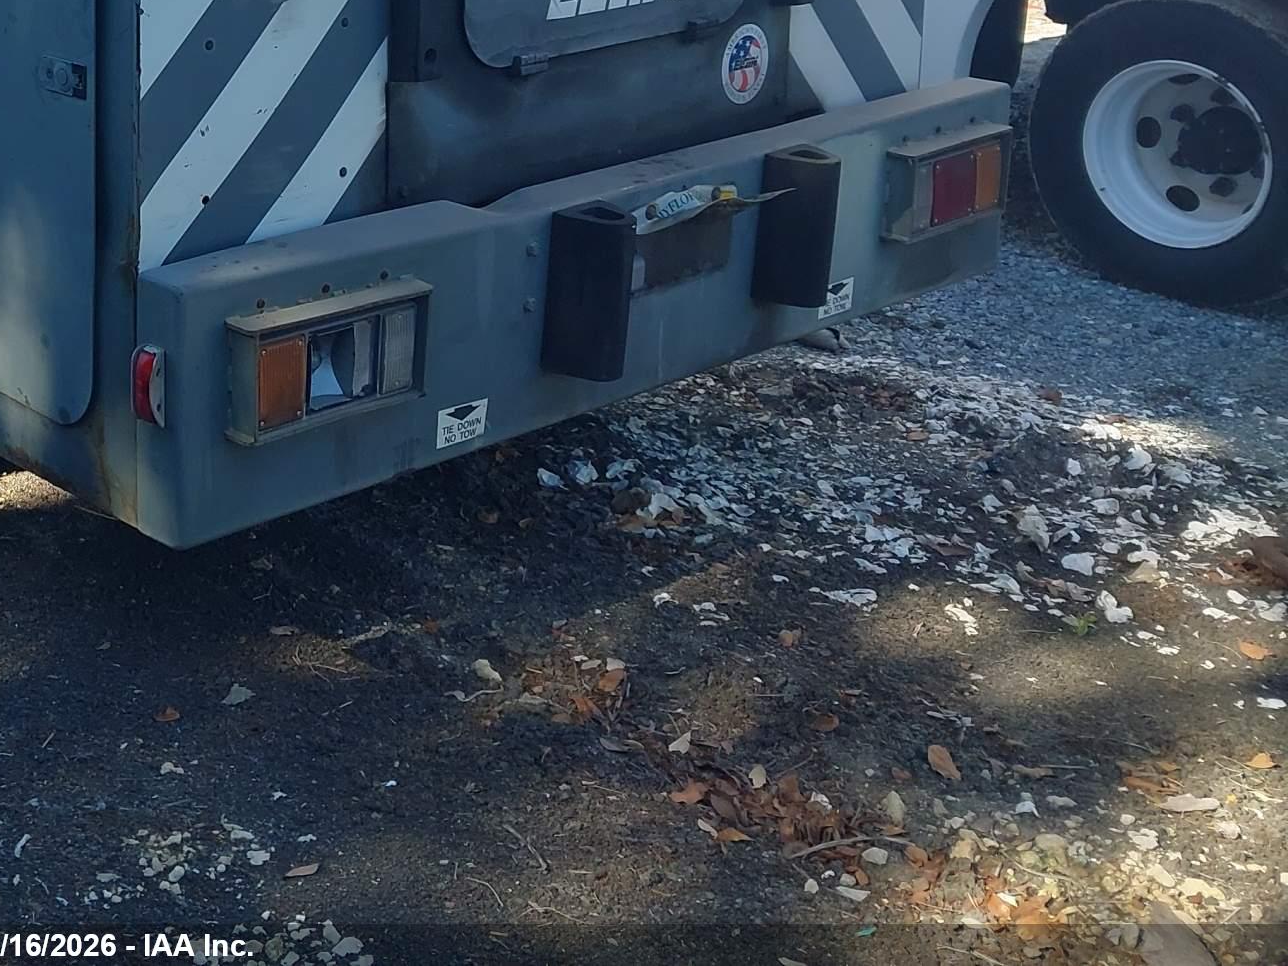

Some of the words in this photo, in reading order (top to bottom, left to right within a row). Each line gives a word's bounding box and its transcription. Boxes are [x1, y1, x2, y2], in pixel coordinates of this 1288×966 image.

[442, 424, 455, 436] TIE
[457, 416, 482, 432] DOWN
[444, 433, 457, 445] NO
[459, 428, 478, 440] TOW
